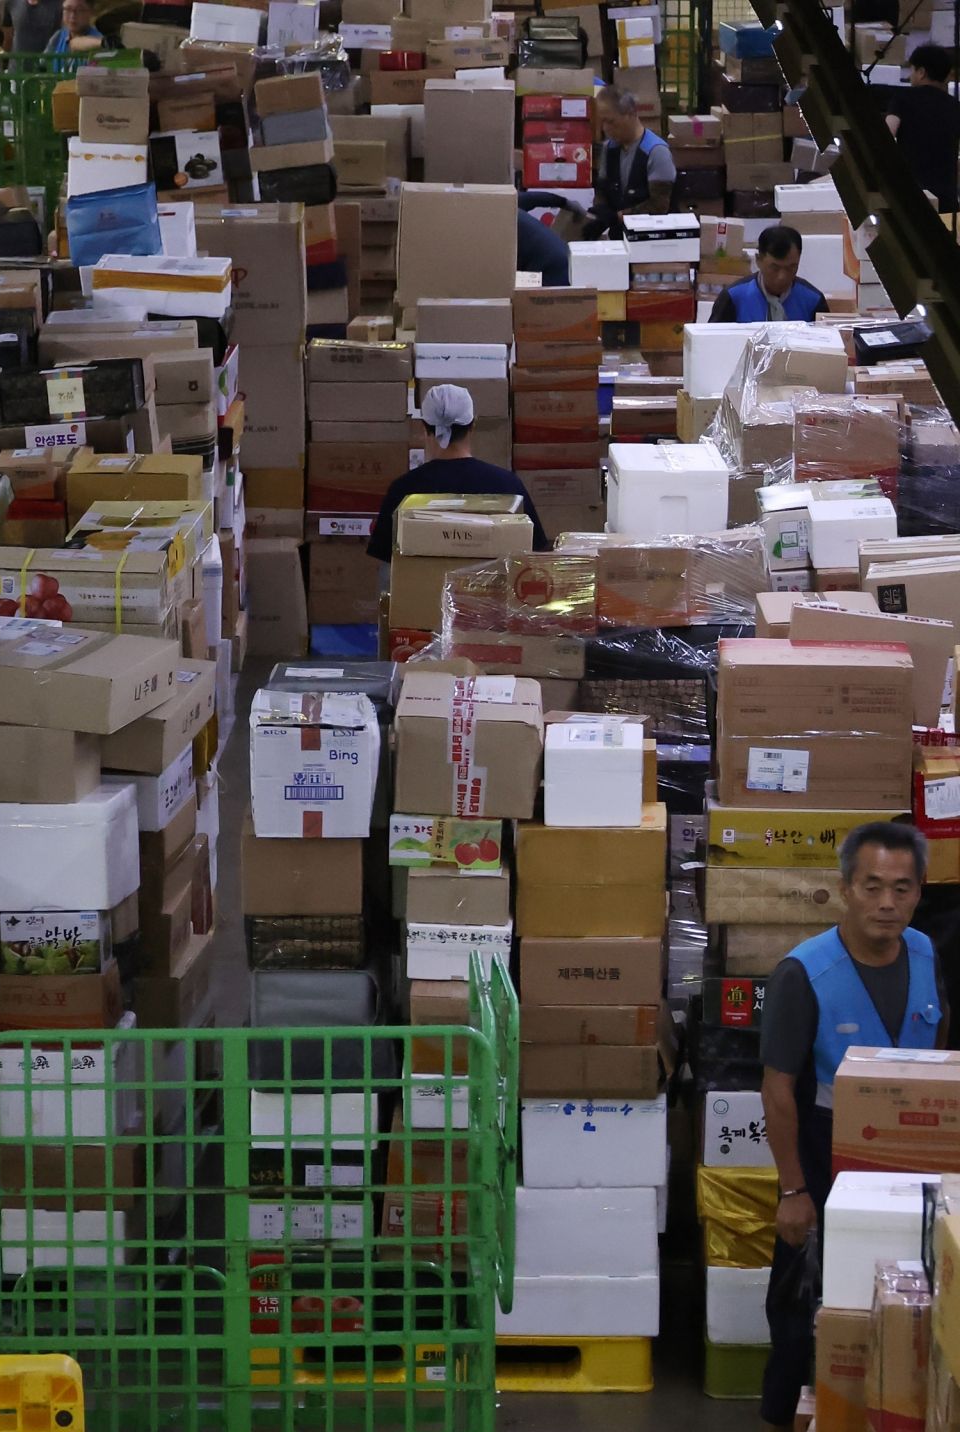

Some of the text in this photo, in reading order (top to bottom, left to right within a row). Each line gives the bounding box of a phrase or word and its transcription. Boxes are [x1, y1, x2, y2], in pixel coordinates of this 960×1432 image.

[34, 433, 78, 448] 안성포도
[329, 749, 359, 765] Bing
[819, 828, 836, 850] 배
[45, 926, 83, 949] 알밤
[557, 967, 621, 981] 제주특산품
[37, 991, 68, 1006] 소포
